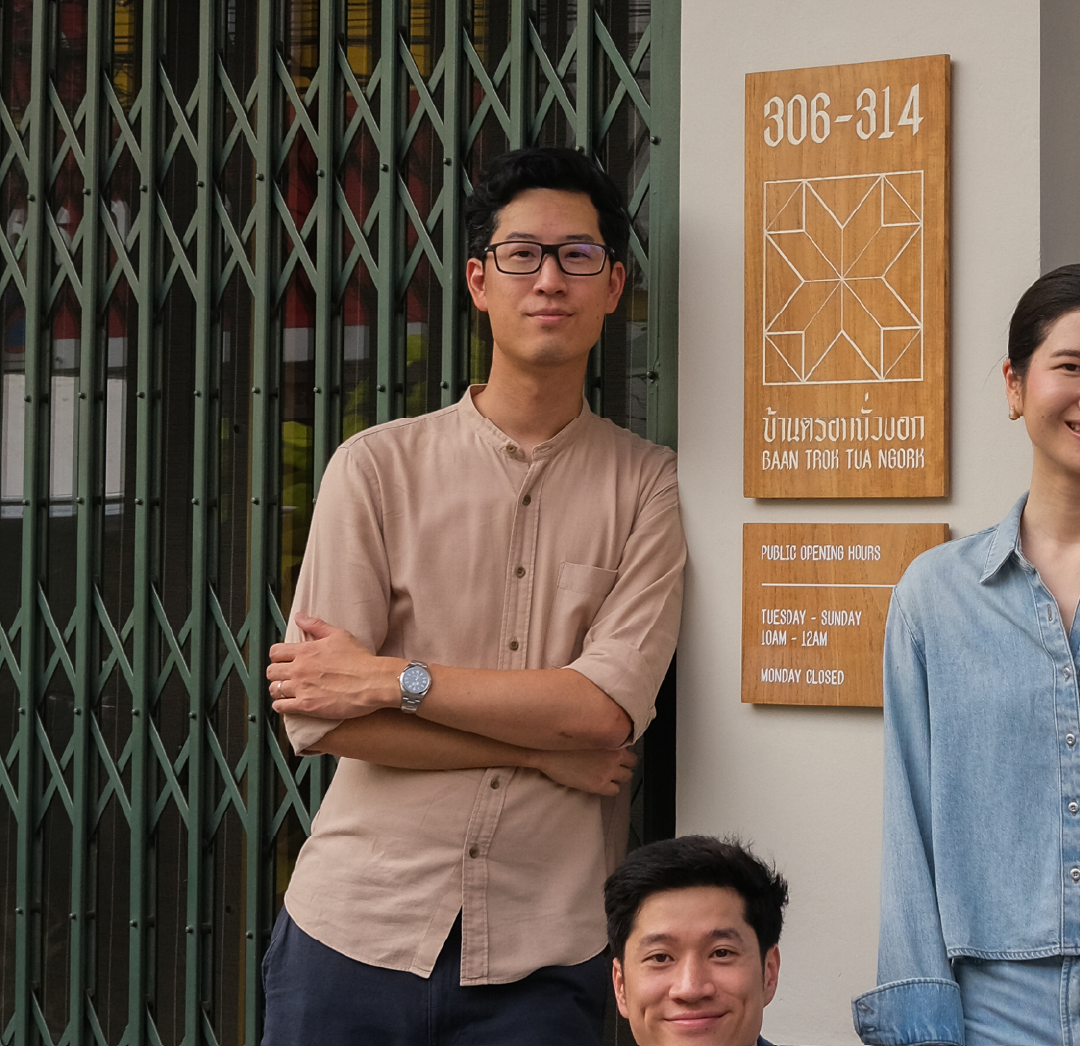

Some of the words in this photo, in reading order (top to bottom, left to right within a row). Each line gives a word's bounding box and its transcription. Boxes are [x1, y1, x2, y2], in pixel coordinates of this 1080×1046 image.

[763, 83, 925, 148] 306-314
[762, 449, 799, 471] BAAN
[805, 449, 839, 470] TROK
[845, 448, 872, 470] TUA
[877, 447, 925, 470] NGORK
[761, 544, 797, 561] PUBLIC
[800, 544, 844, 561] OPENING
[847, 544, 881, 561] HOURS
[761, 608, 806, 626] TUESDAY
[821, 609, 862, 627] SUNDAY
[761, 629, 787, 646] 10AM
[801, 630, 828, 647] 12AM
[761, 667, 802, 684] MONDAY
[806, 668, 845, 685] CLOSED
